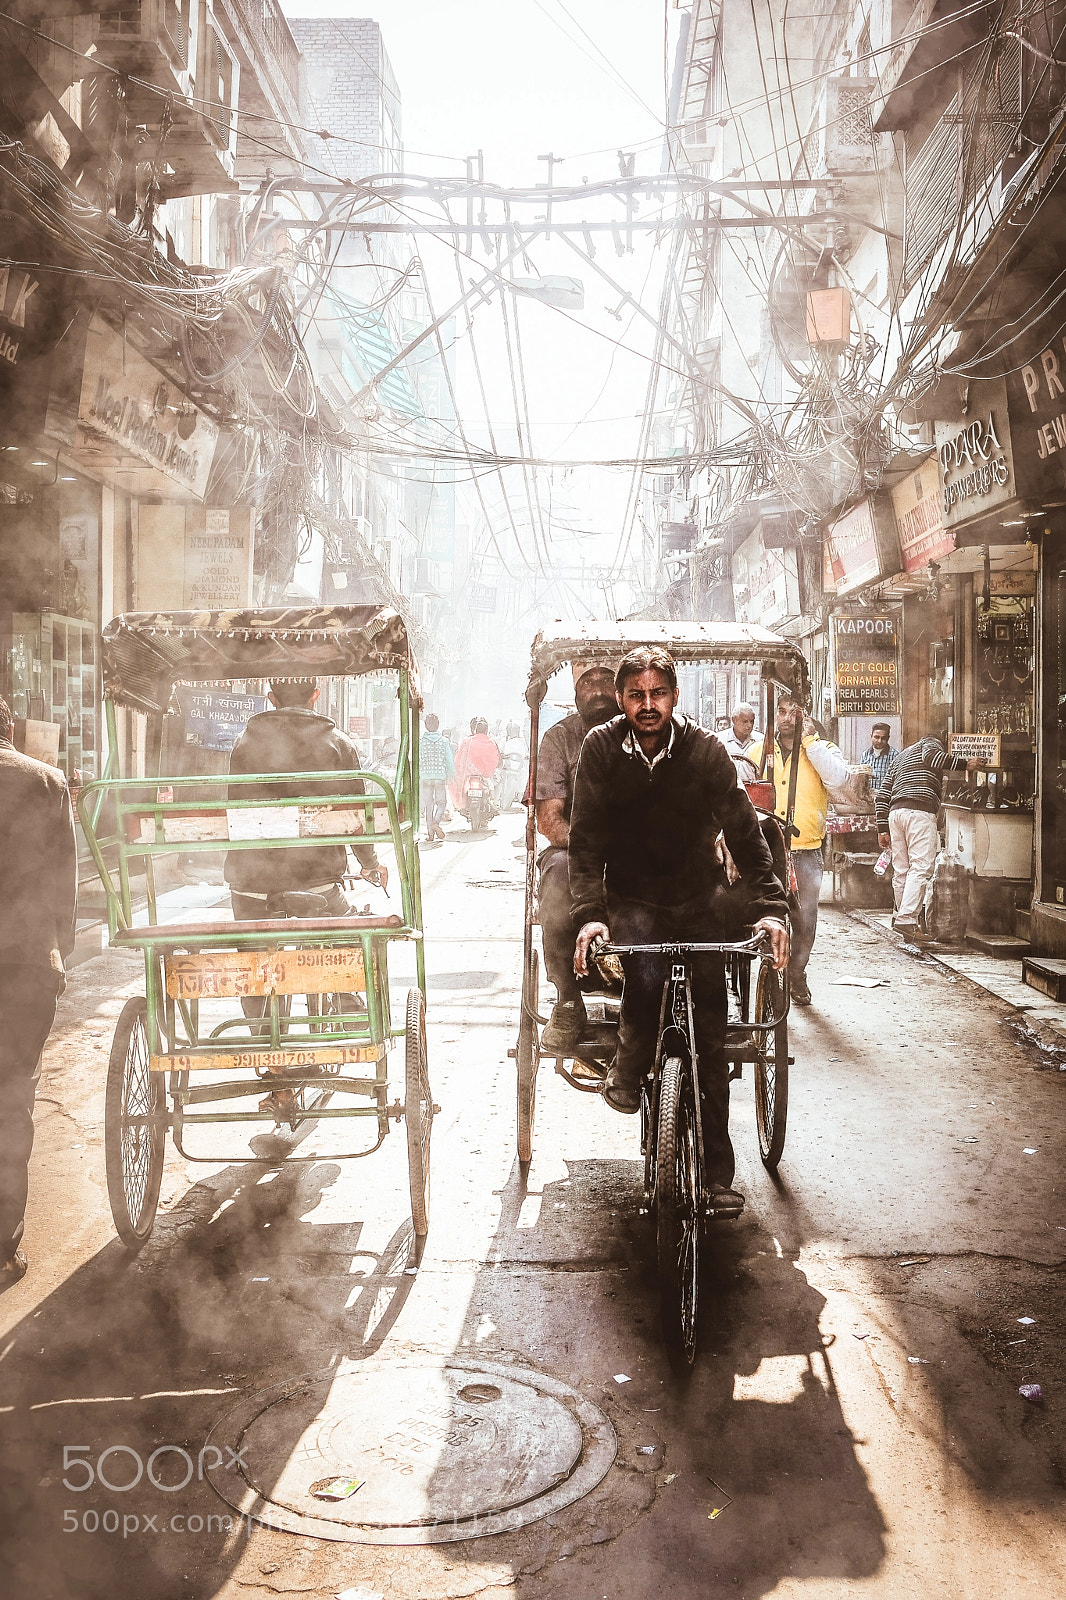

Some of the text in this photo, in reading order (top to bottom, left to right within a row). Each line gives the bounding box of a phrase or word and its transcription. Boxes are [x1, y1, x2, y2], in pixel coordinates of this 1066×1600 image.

[1021, 336, 1066, 412] PR
[943, 455, 1009, 515] JEWELLERS
[214, 537, 244, 548] PADAM
[200, 552, 234, 563] JEWELS
[203, 567, 229, 575] GOLD
[202, 584, 240, 592] KUNDAN
[190, 592, 240, 600] JEWELLERY
[837, 619, 894, 634] KAPOOR
[839, 662, 896, 672] 22 CT GOLD
[840, 676, 896, 686] ORNAMENTS
[840, 688, 896, 698] REAL PEARLS &
[840, 702, 896, 712] BIRTH STONES
[262, 963, 285, 983] 19
